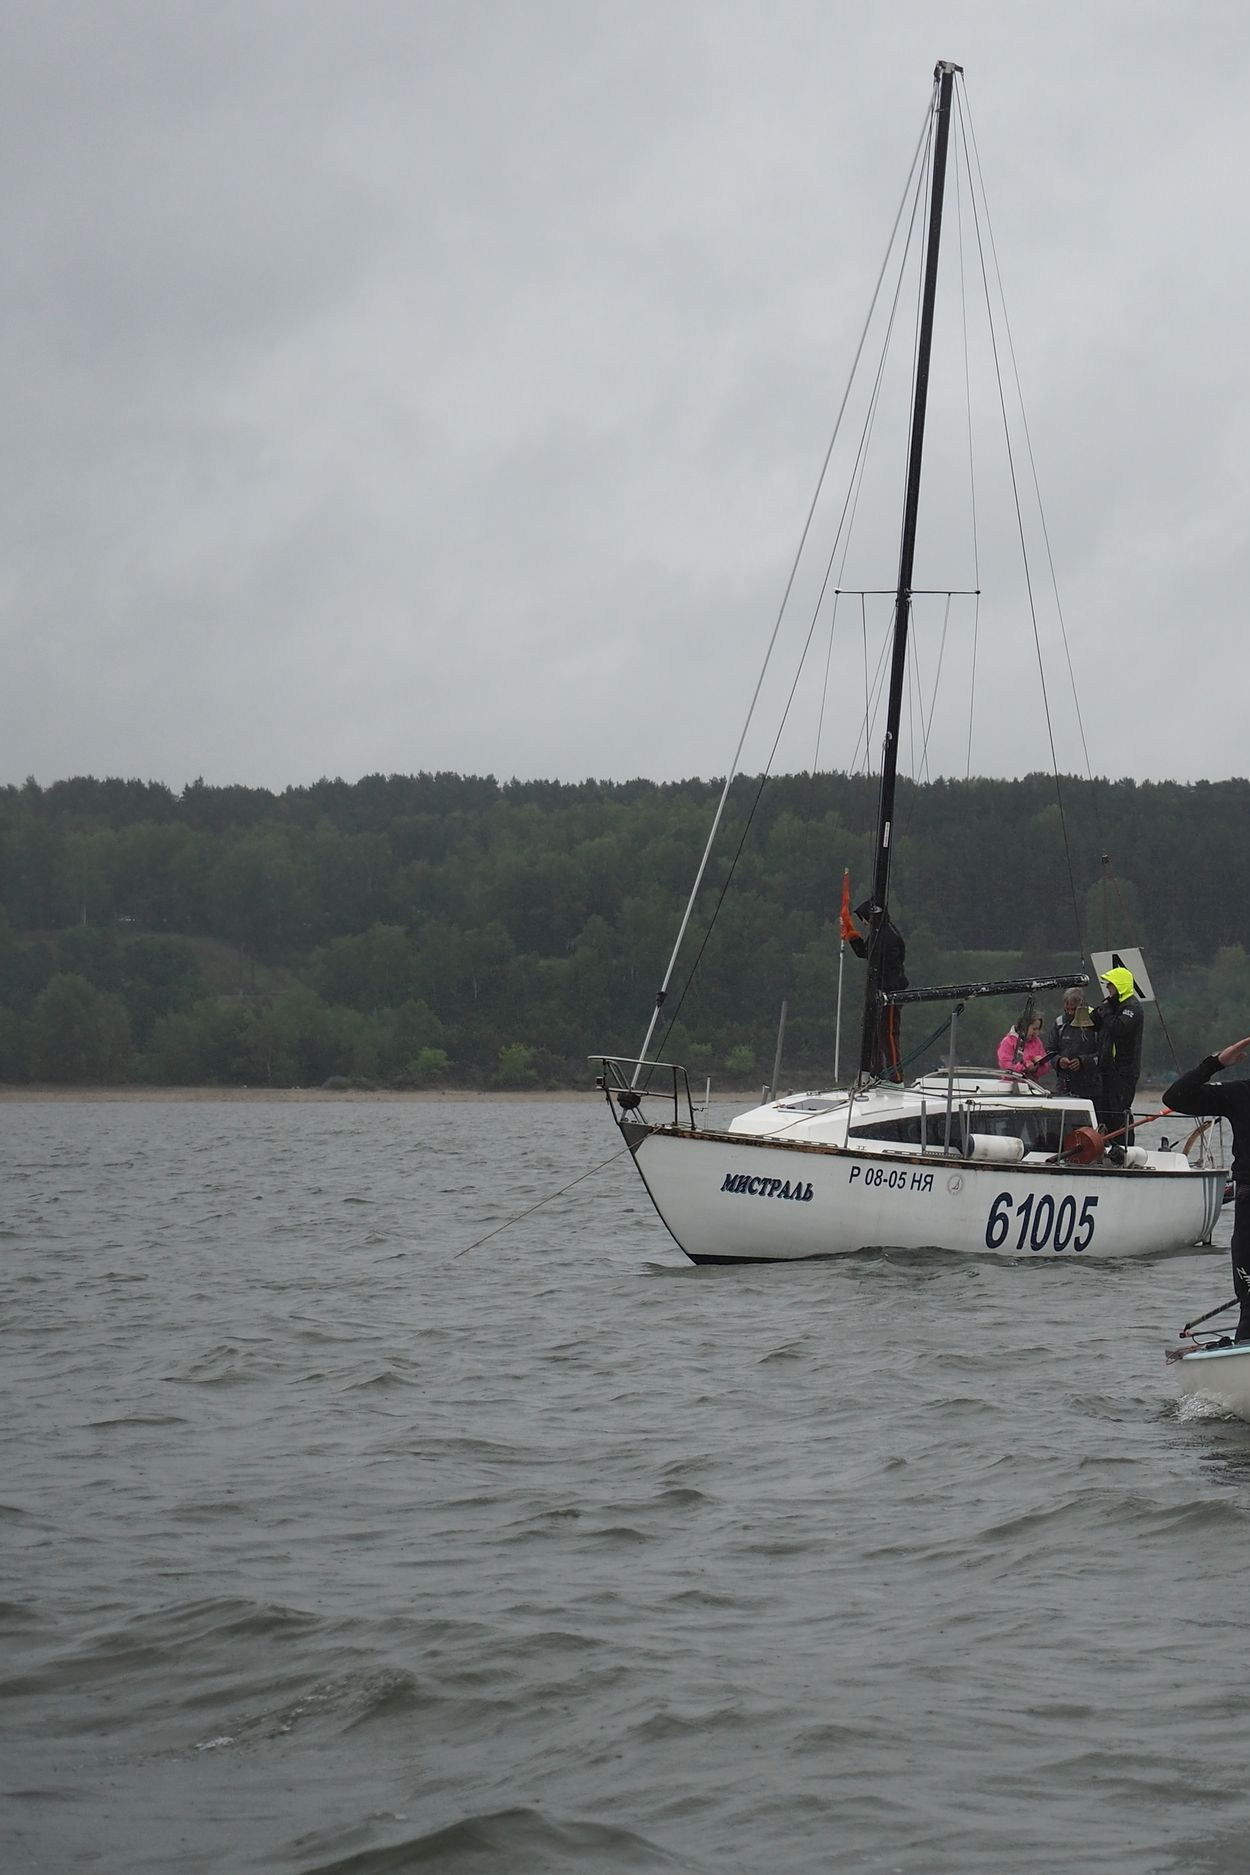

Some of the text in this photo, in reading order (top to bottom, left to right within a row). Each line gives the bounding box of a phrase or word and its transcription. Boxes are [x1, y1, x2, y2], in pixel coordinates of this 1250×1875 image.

[719, 1173, 814, 1202] МИСТРАЛЬ
[865, 1167, 907, 1189] 08-05
[910, 1172, 934, 1192] НЯ
[984, 1191, 1099, 1253] 61005
